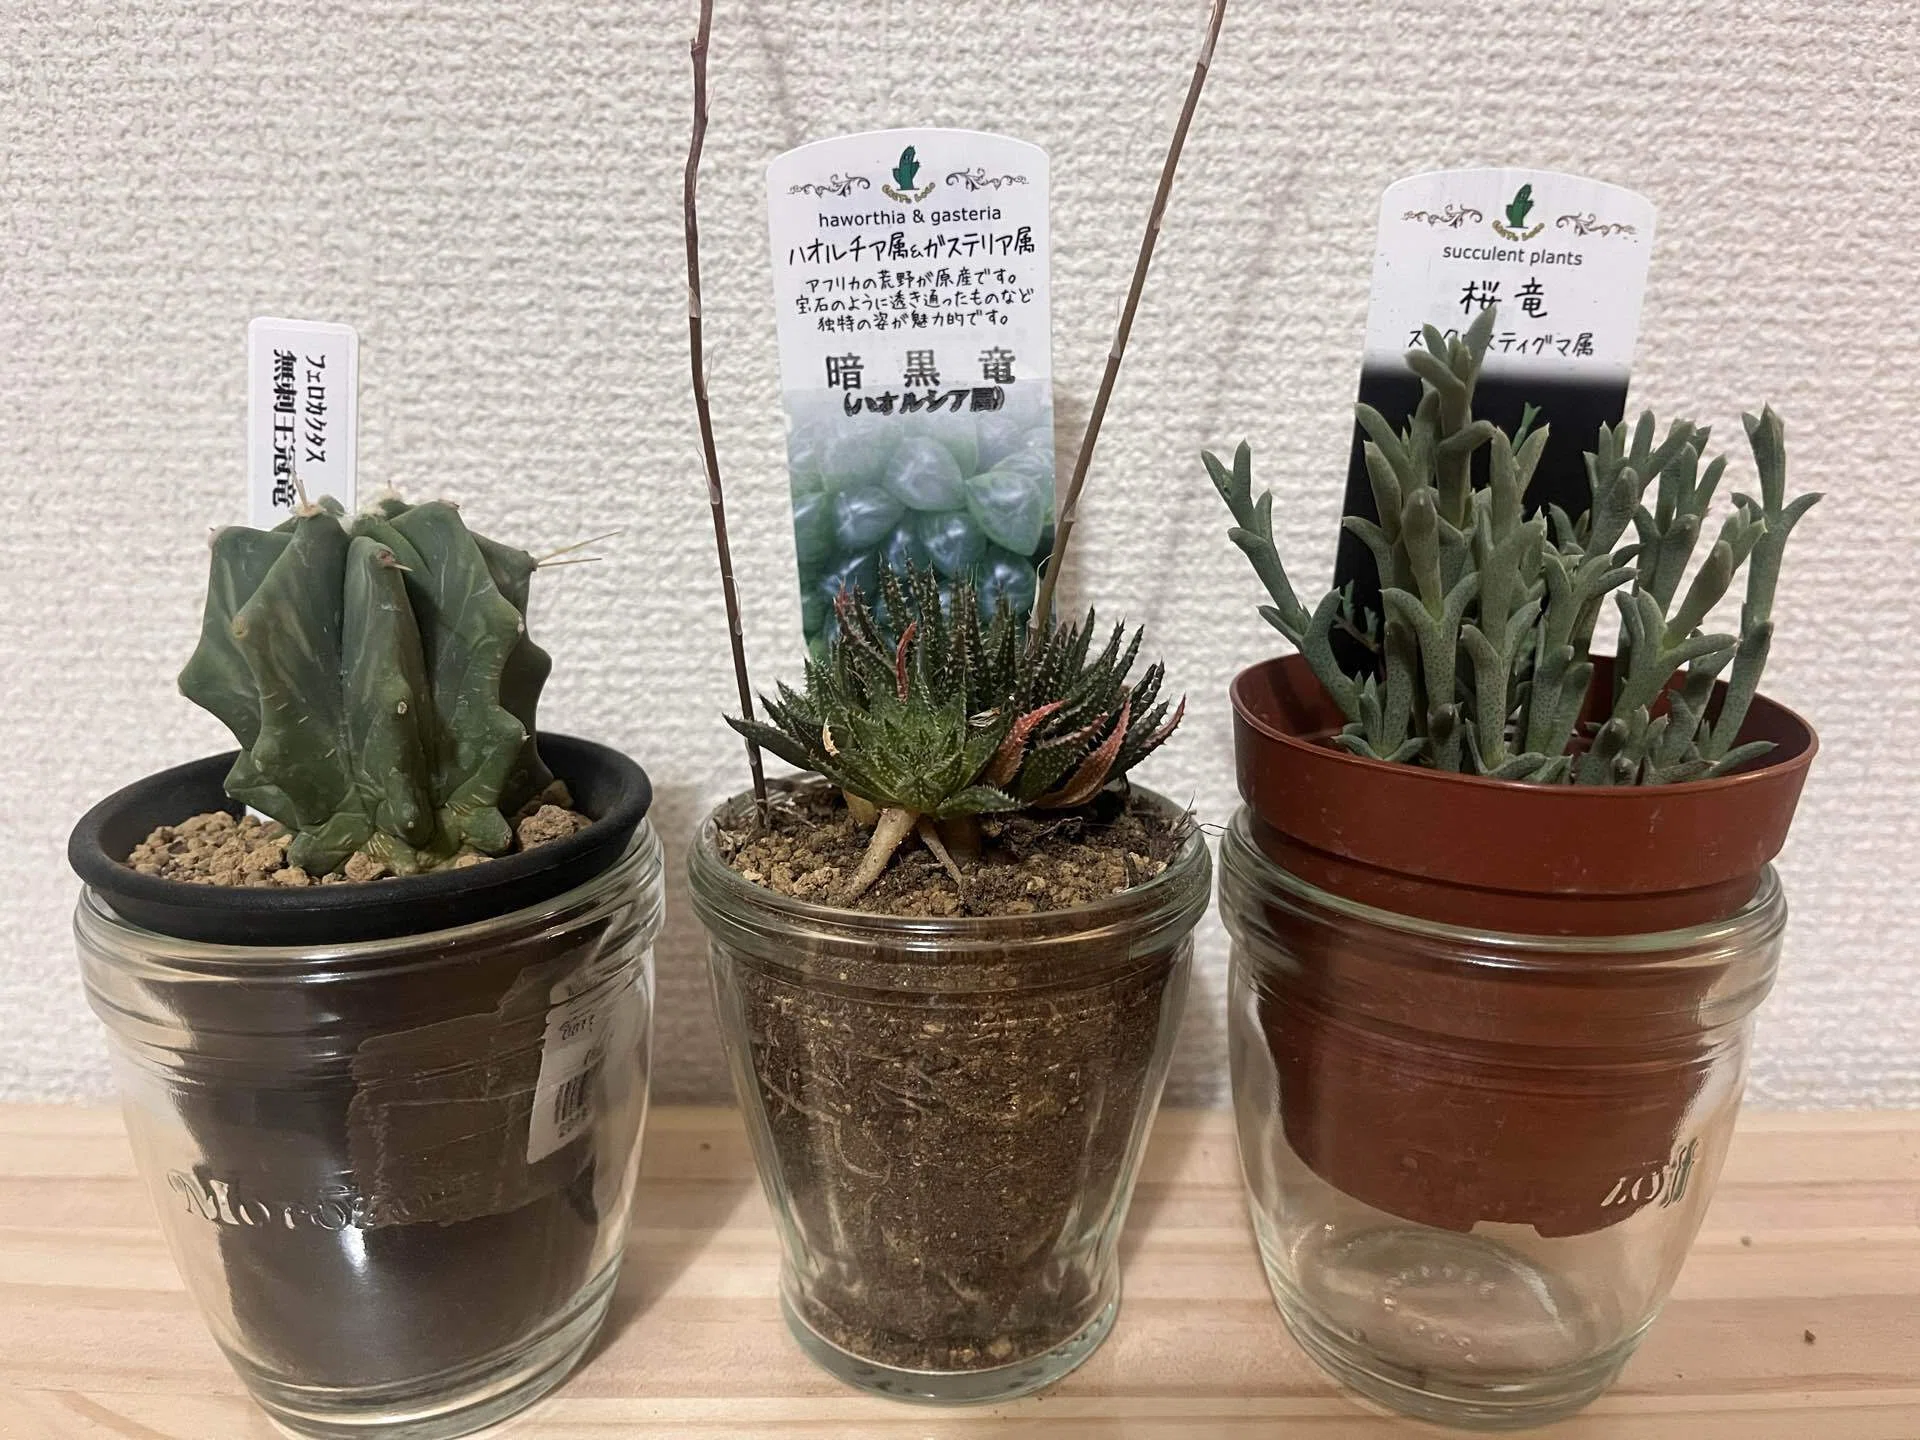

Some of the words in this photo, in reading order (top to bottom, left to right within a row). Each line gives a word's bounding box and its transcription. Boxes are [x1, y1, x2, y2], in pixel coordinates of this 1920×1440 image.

[818, 210, 906, 228] haworthia
[912, 209, 925, 223] &
[930, 206, 1002, 226] gasteria
[1442, 246, 1525, 263] succulent
[1529, 249, 1584, 267] plants
[805, 266, 1017, 293] アフリカの荒野が原産です。
[795, 287, 1035, 315] 宝石のように透き通ったものなど
[816, 308, 1009, 333] 独特の姿が魅力的です。
[1407, 329, 1595, 357] ススティグマ属
[305, 353, 328, 463] フェロカクタス
[272, 348, 298, 508] 無刺王冠竜
